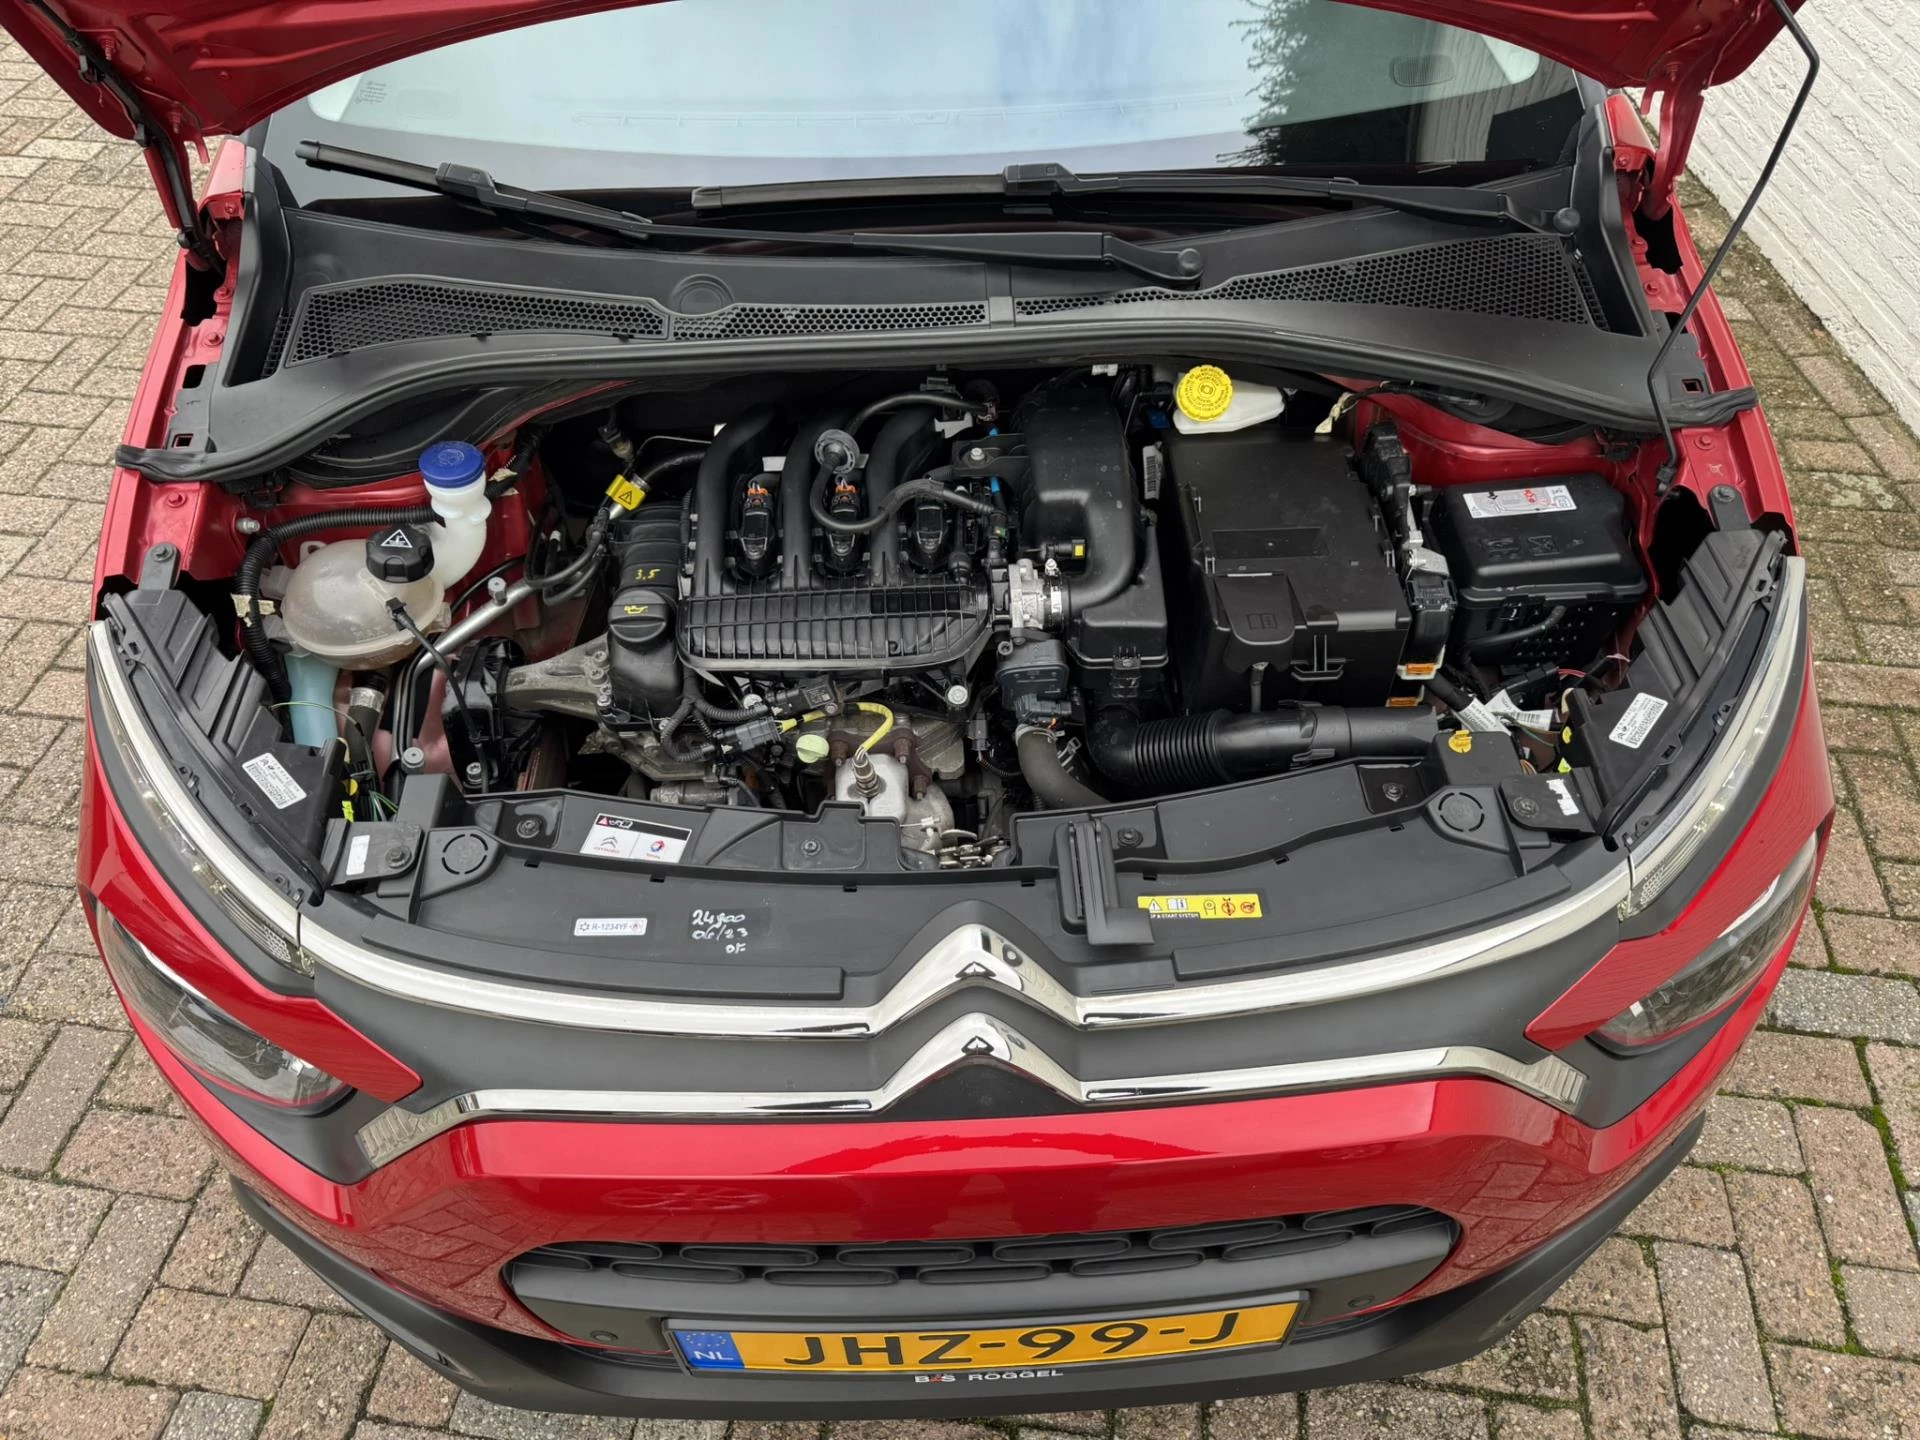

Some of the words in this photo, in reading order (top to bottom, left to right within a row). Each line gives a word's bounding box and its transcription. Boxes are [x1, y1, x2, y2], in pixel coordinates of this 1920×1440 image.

[635, 569, 661, 580] 3.5
[784, 1312, 1240, 1366] JHZ-99-J
[693, 1350, 735, 1362] NL
[968, 1370, 1064, 1381] ROGGEL
